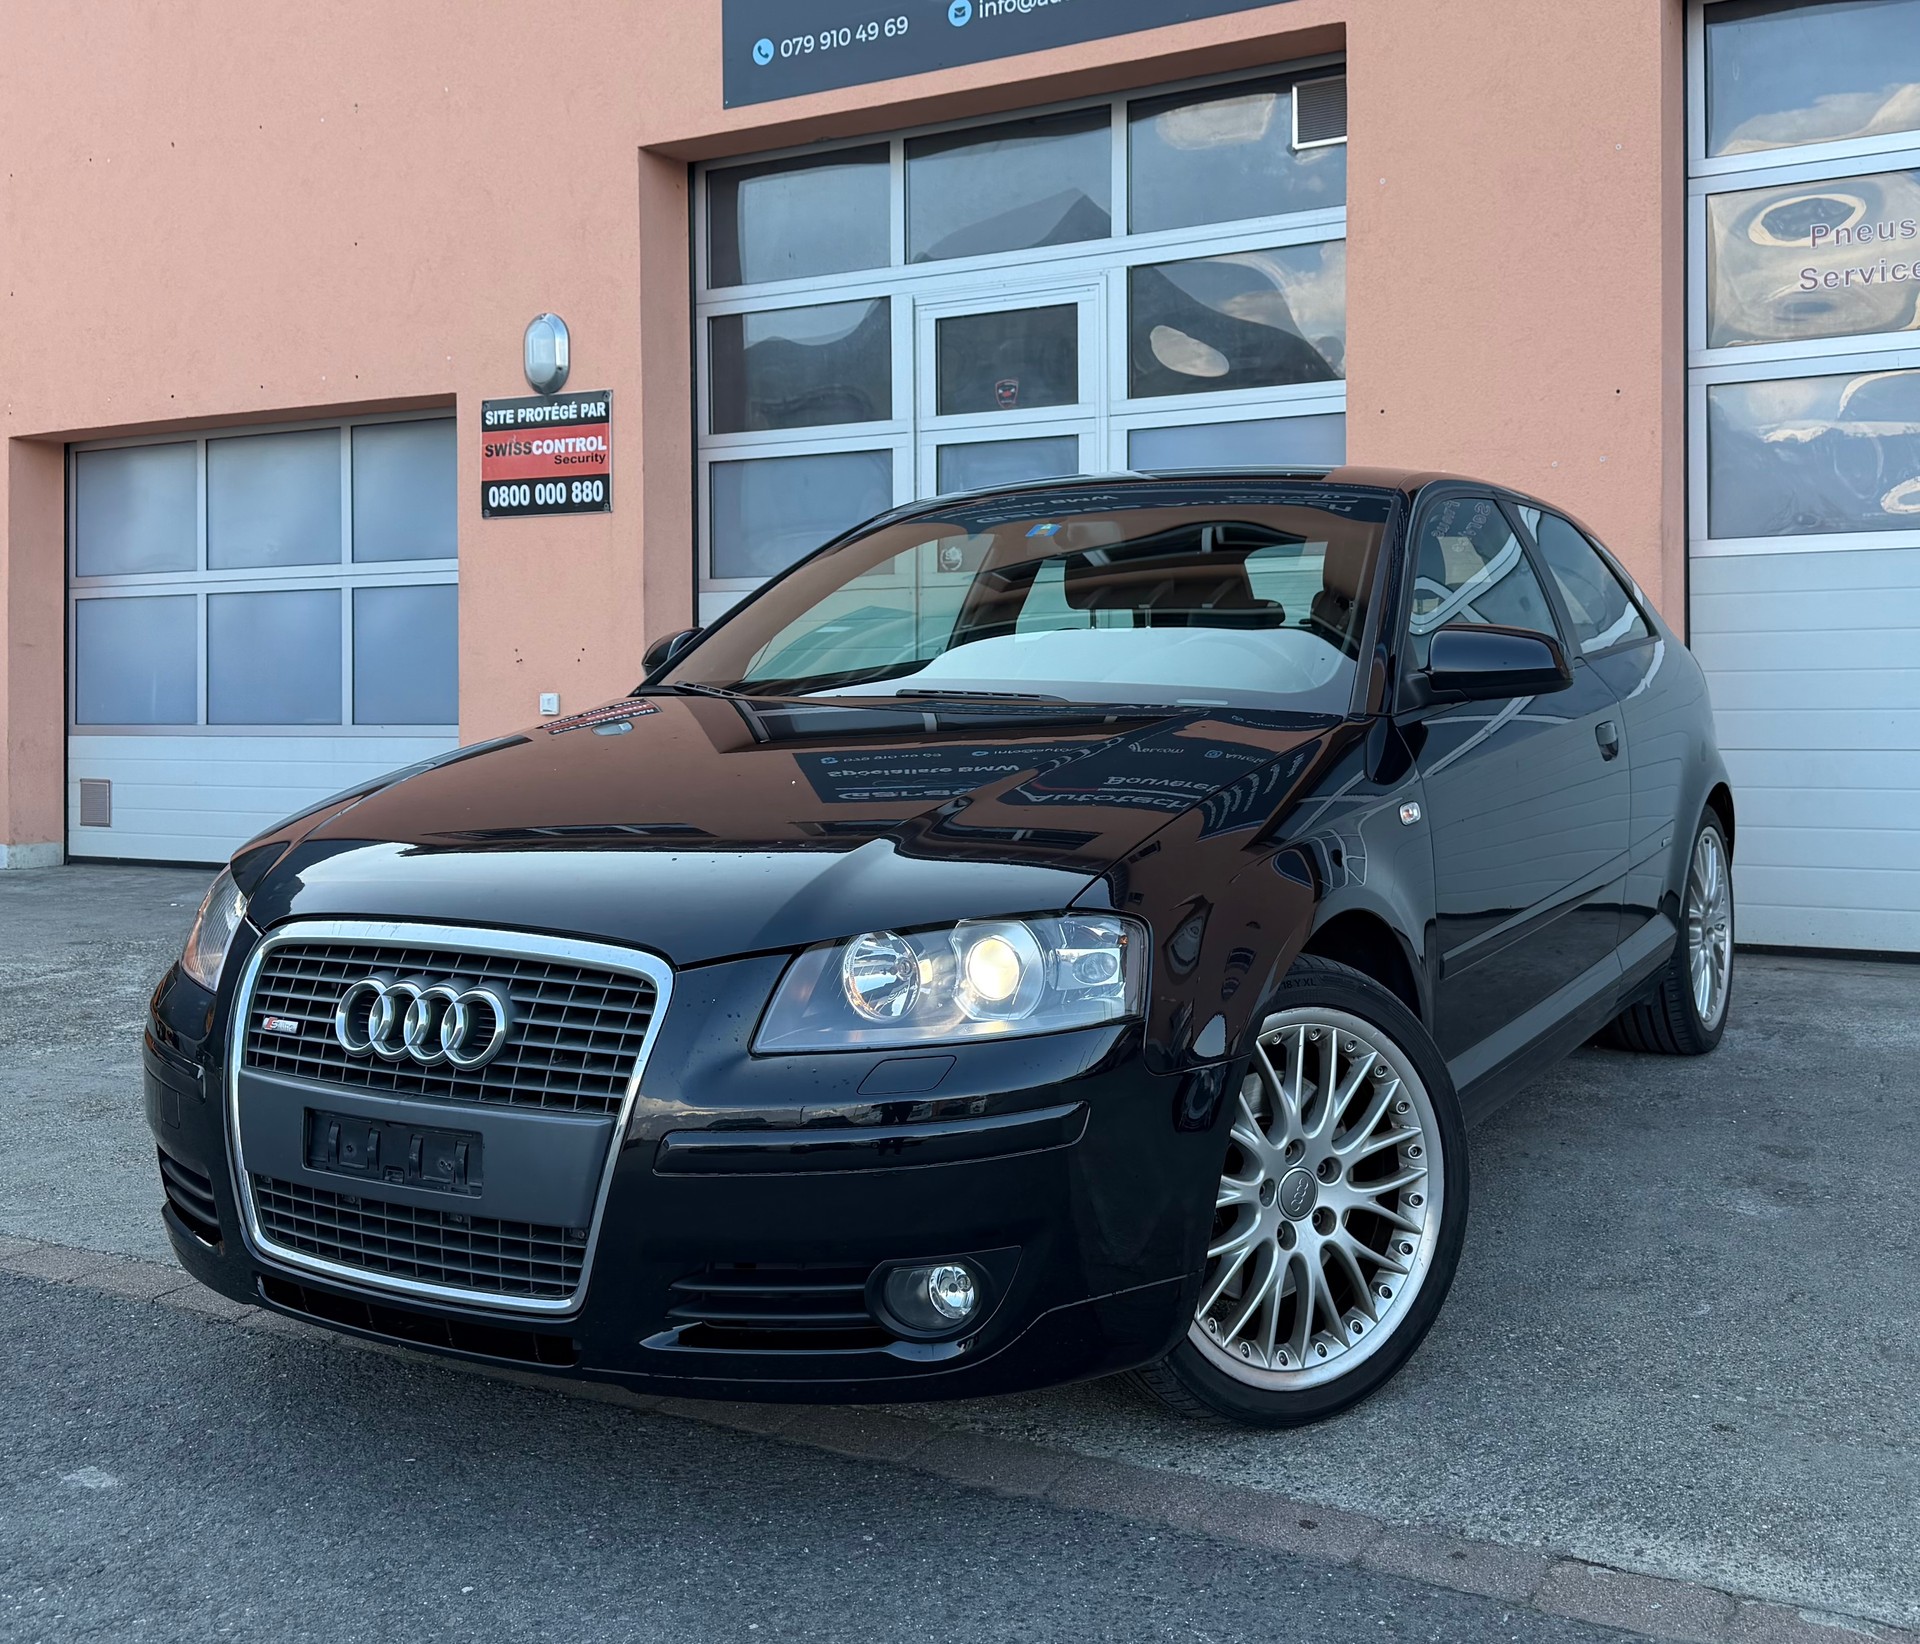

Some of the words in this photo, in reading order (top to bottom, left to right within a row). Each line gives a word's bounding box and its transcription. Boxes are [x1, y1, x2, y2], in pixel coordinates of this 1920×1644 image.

[780, 34, 815, 58] 079
[819, 27, 852, 51] 910
[855, 21, 880, 42] 49
[884, 15, 909, 38] 69
[1810, 218, 1918, 249] Pneus
[485, 409, 514, 425] SITE
[517, 401, 578, 423] PROTÉGÉ
[580, 401, 606, 418] PAR
[554, 452, 606, 465] Security
[488, 484, 531, 508] 0800
[534, 482, 567, 506] 000
[571, 480, 604, 504] 880
